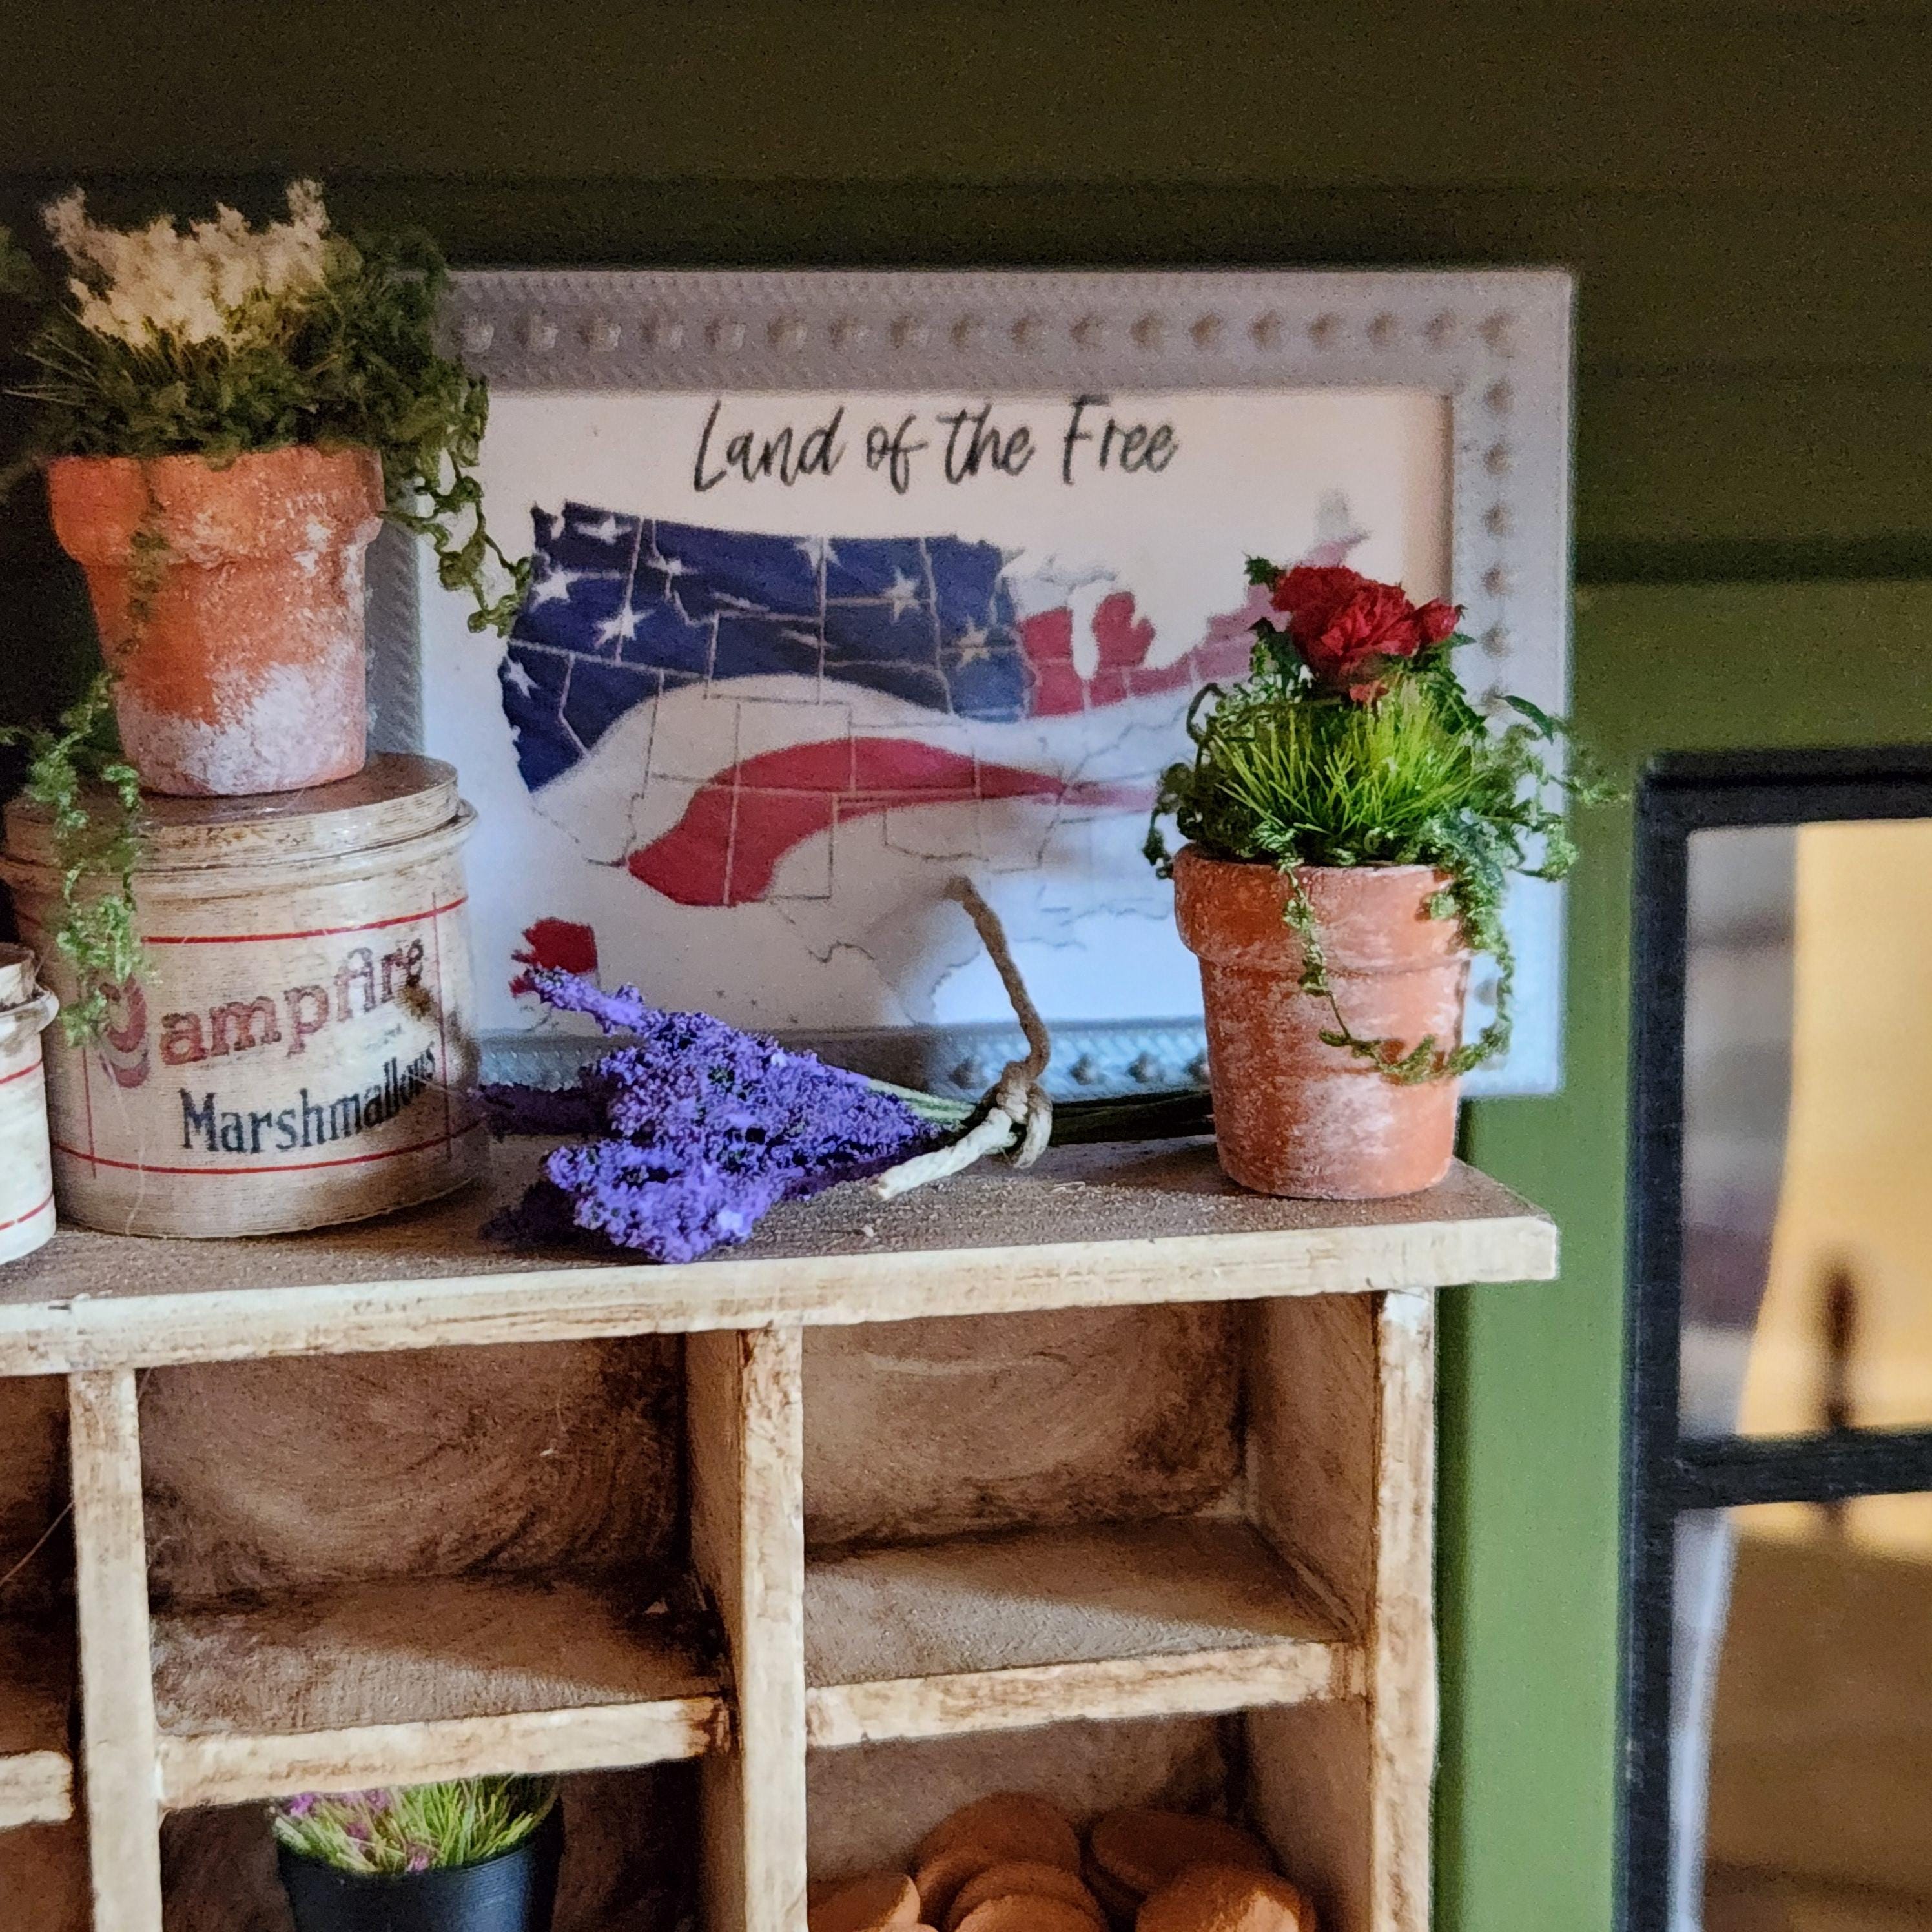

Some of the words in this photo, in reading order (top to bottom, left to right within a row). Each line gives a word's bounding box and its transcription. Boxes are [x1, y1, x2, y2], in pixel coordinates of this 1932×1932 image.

[694, 399, 845, 493] Land
[866, 413, 928, 495] of
[936, 402, 1036, 484] the
[1063, 393, 1180, 486] Free
